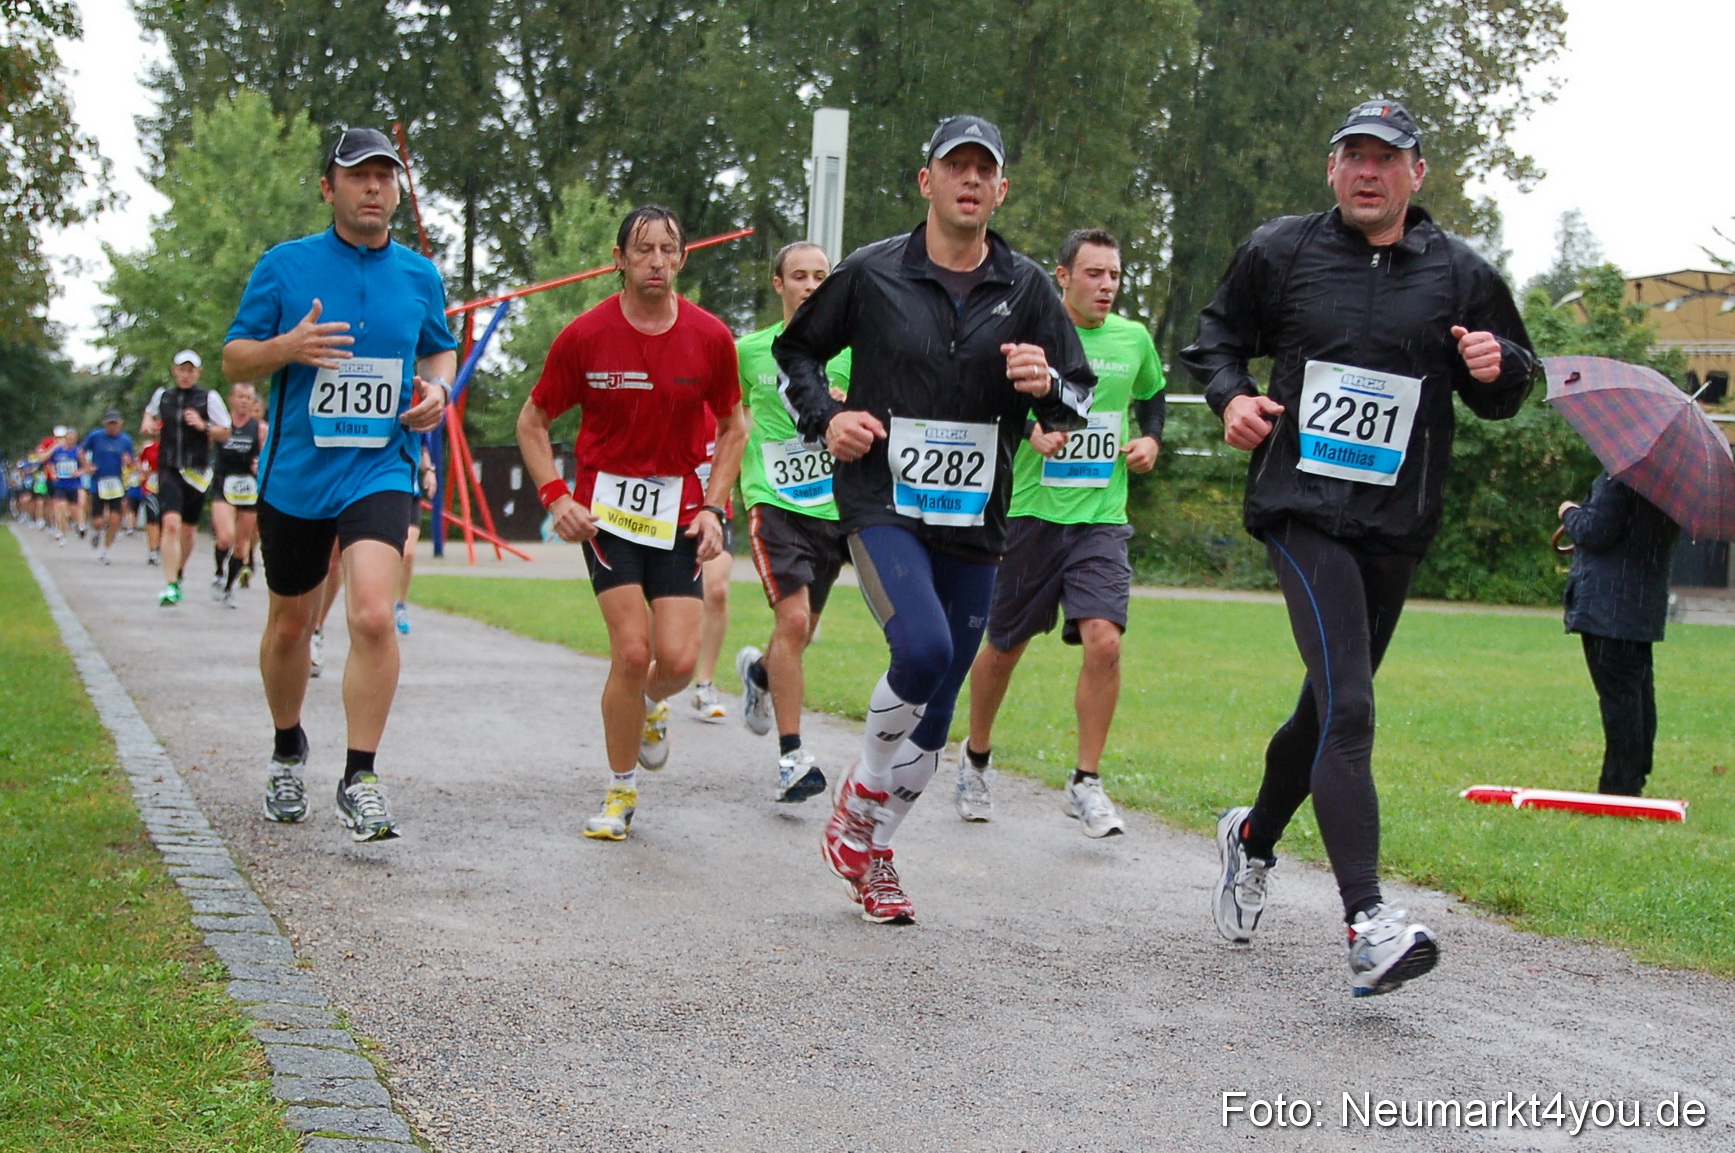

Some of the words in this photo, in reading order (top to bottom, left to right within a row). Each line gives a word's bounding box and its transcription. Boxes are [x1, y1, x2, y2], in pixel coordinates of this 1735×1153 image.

[317, 382, 392, 414] 2130
[335, 421, 368, 434] Klaus
[1306, 391, 1400, 444] 2281
[900, 447, 985, 487] 2282
[1312, 440, 1376, 467] Matthias
[774, 450, 833, 485] 3328
[1067, 465, 1099, 477] Julian
[616, 480, 660, 516] 191
[793, 484, 823, 499] Stefan
[916, 493, 962, 510] Markus
[608, 511, 657, 537] Wolfgang
